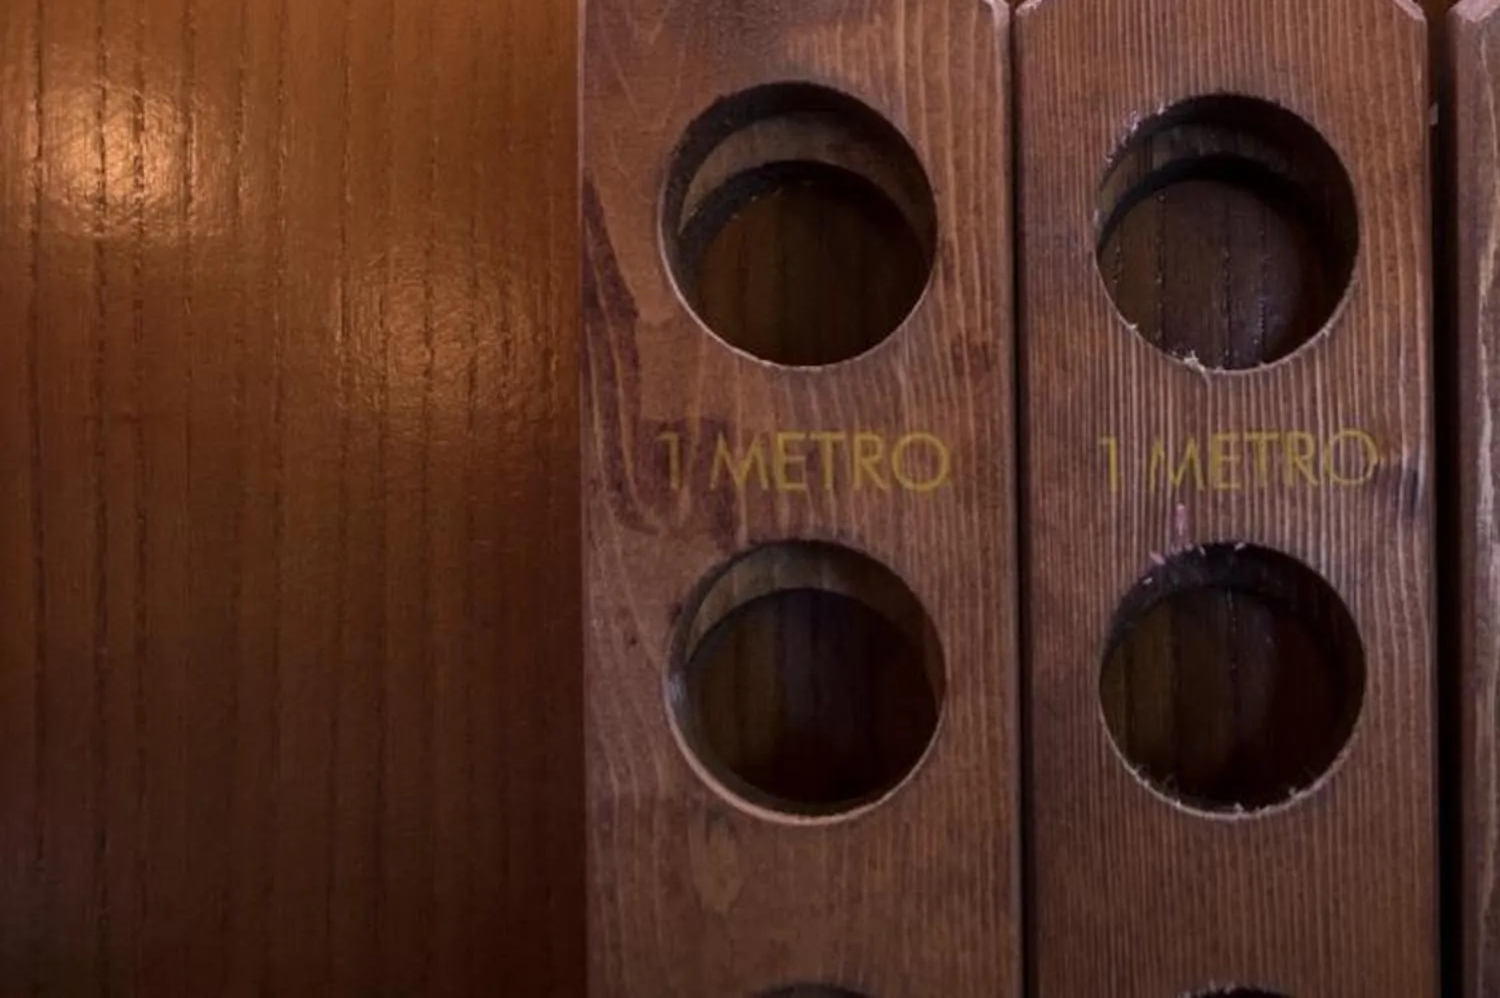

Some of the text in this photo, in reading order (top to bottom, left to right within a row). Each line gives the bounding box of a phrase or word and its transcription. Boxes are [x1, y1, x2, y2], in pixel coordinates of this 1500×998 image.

[655, 431, 951, 492] 1 METRO
[1099, 429, 1379, 492] 1 METRO
